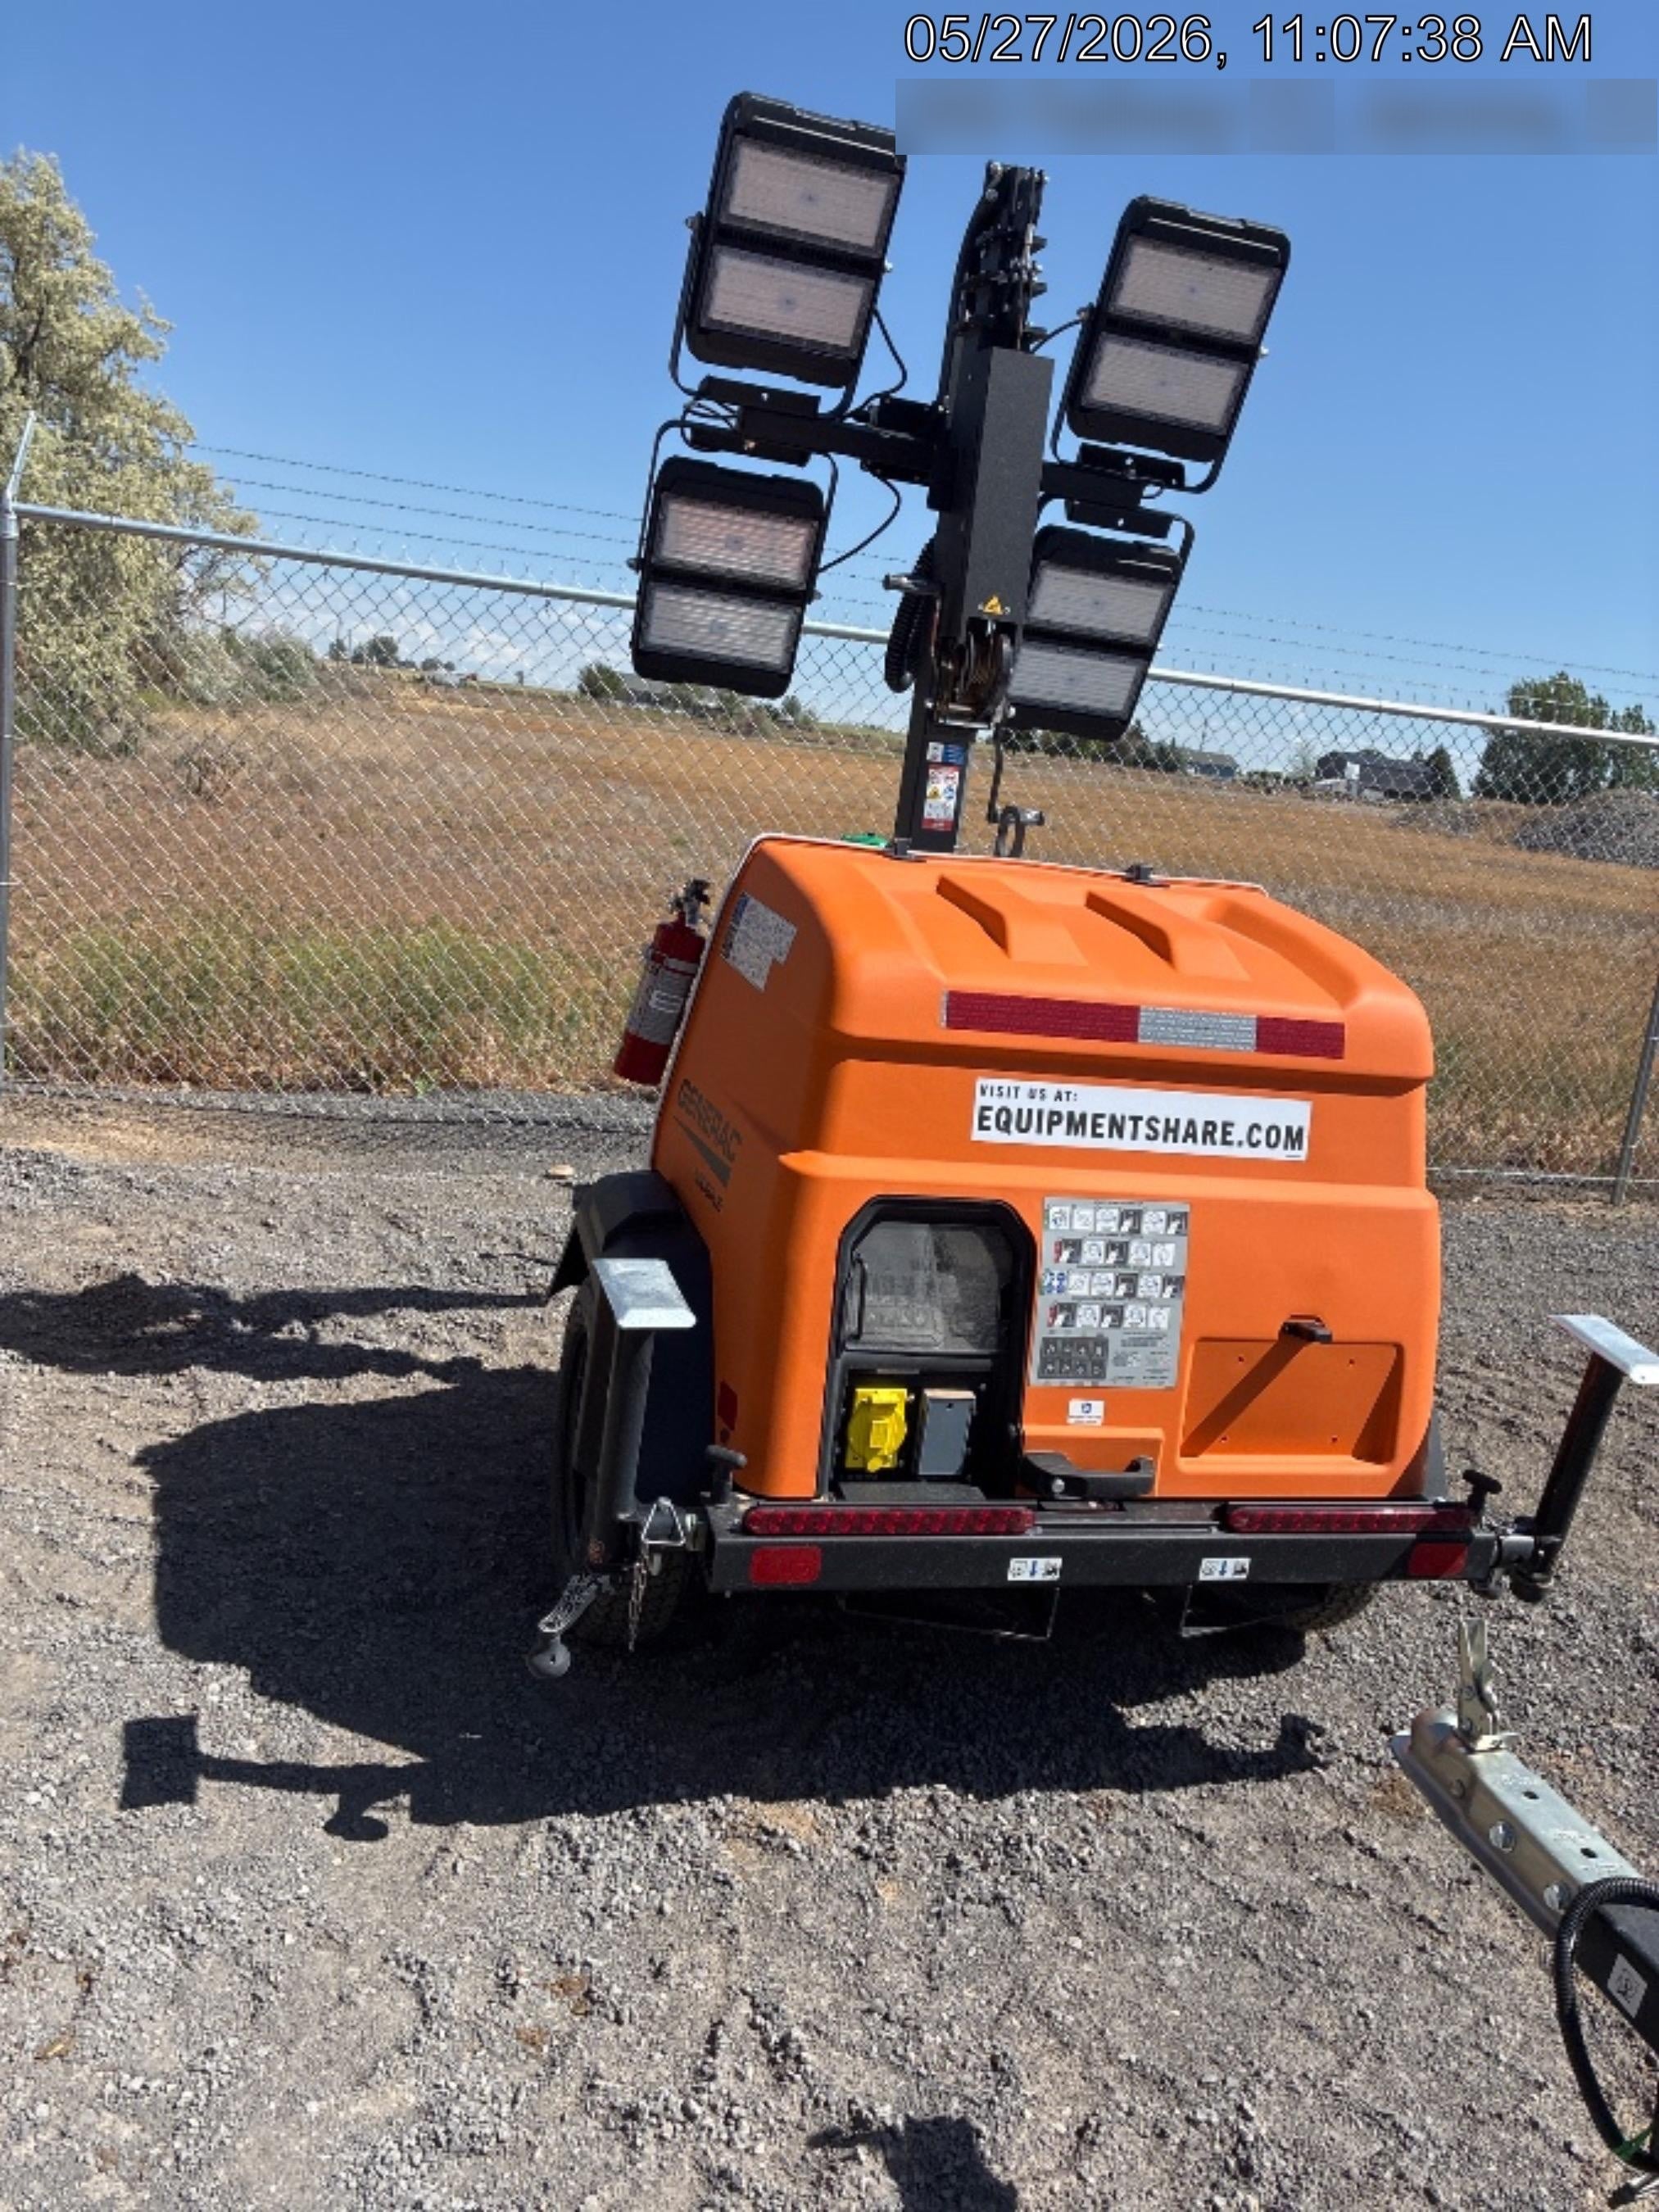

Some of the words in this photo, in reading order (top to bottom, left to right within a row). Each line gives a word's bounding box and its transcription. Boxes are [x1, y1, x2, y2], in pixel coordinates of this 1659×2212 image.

[980, 1083, 1021, 1099] VISIT
[1029, 1088, 1047, 1101] US
[1054, 1090, 1077, 1102] AT:
[977, 1104, 1304, 1151] EQUIPMENTSHARE.COM
